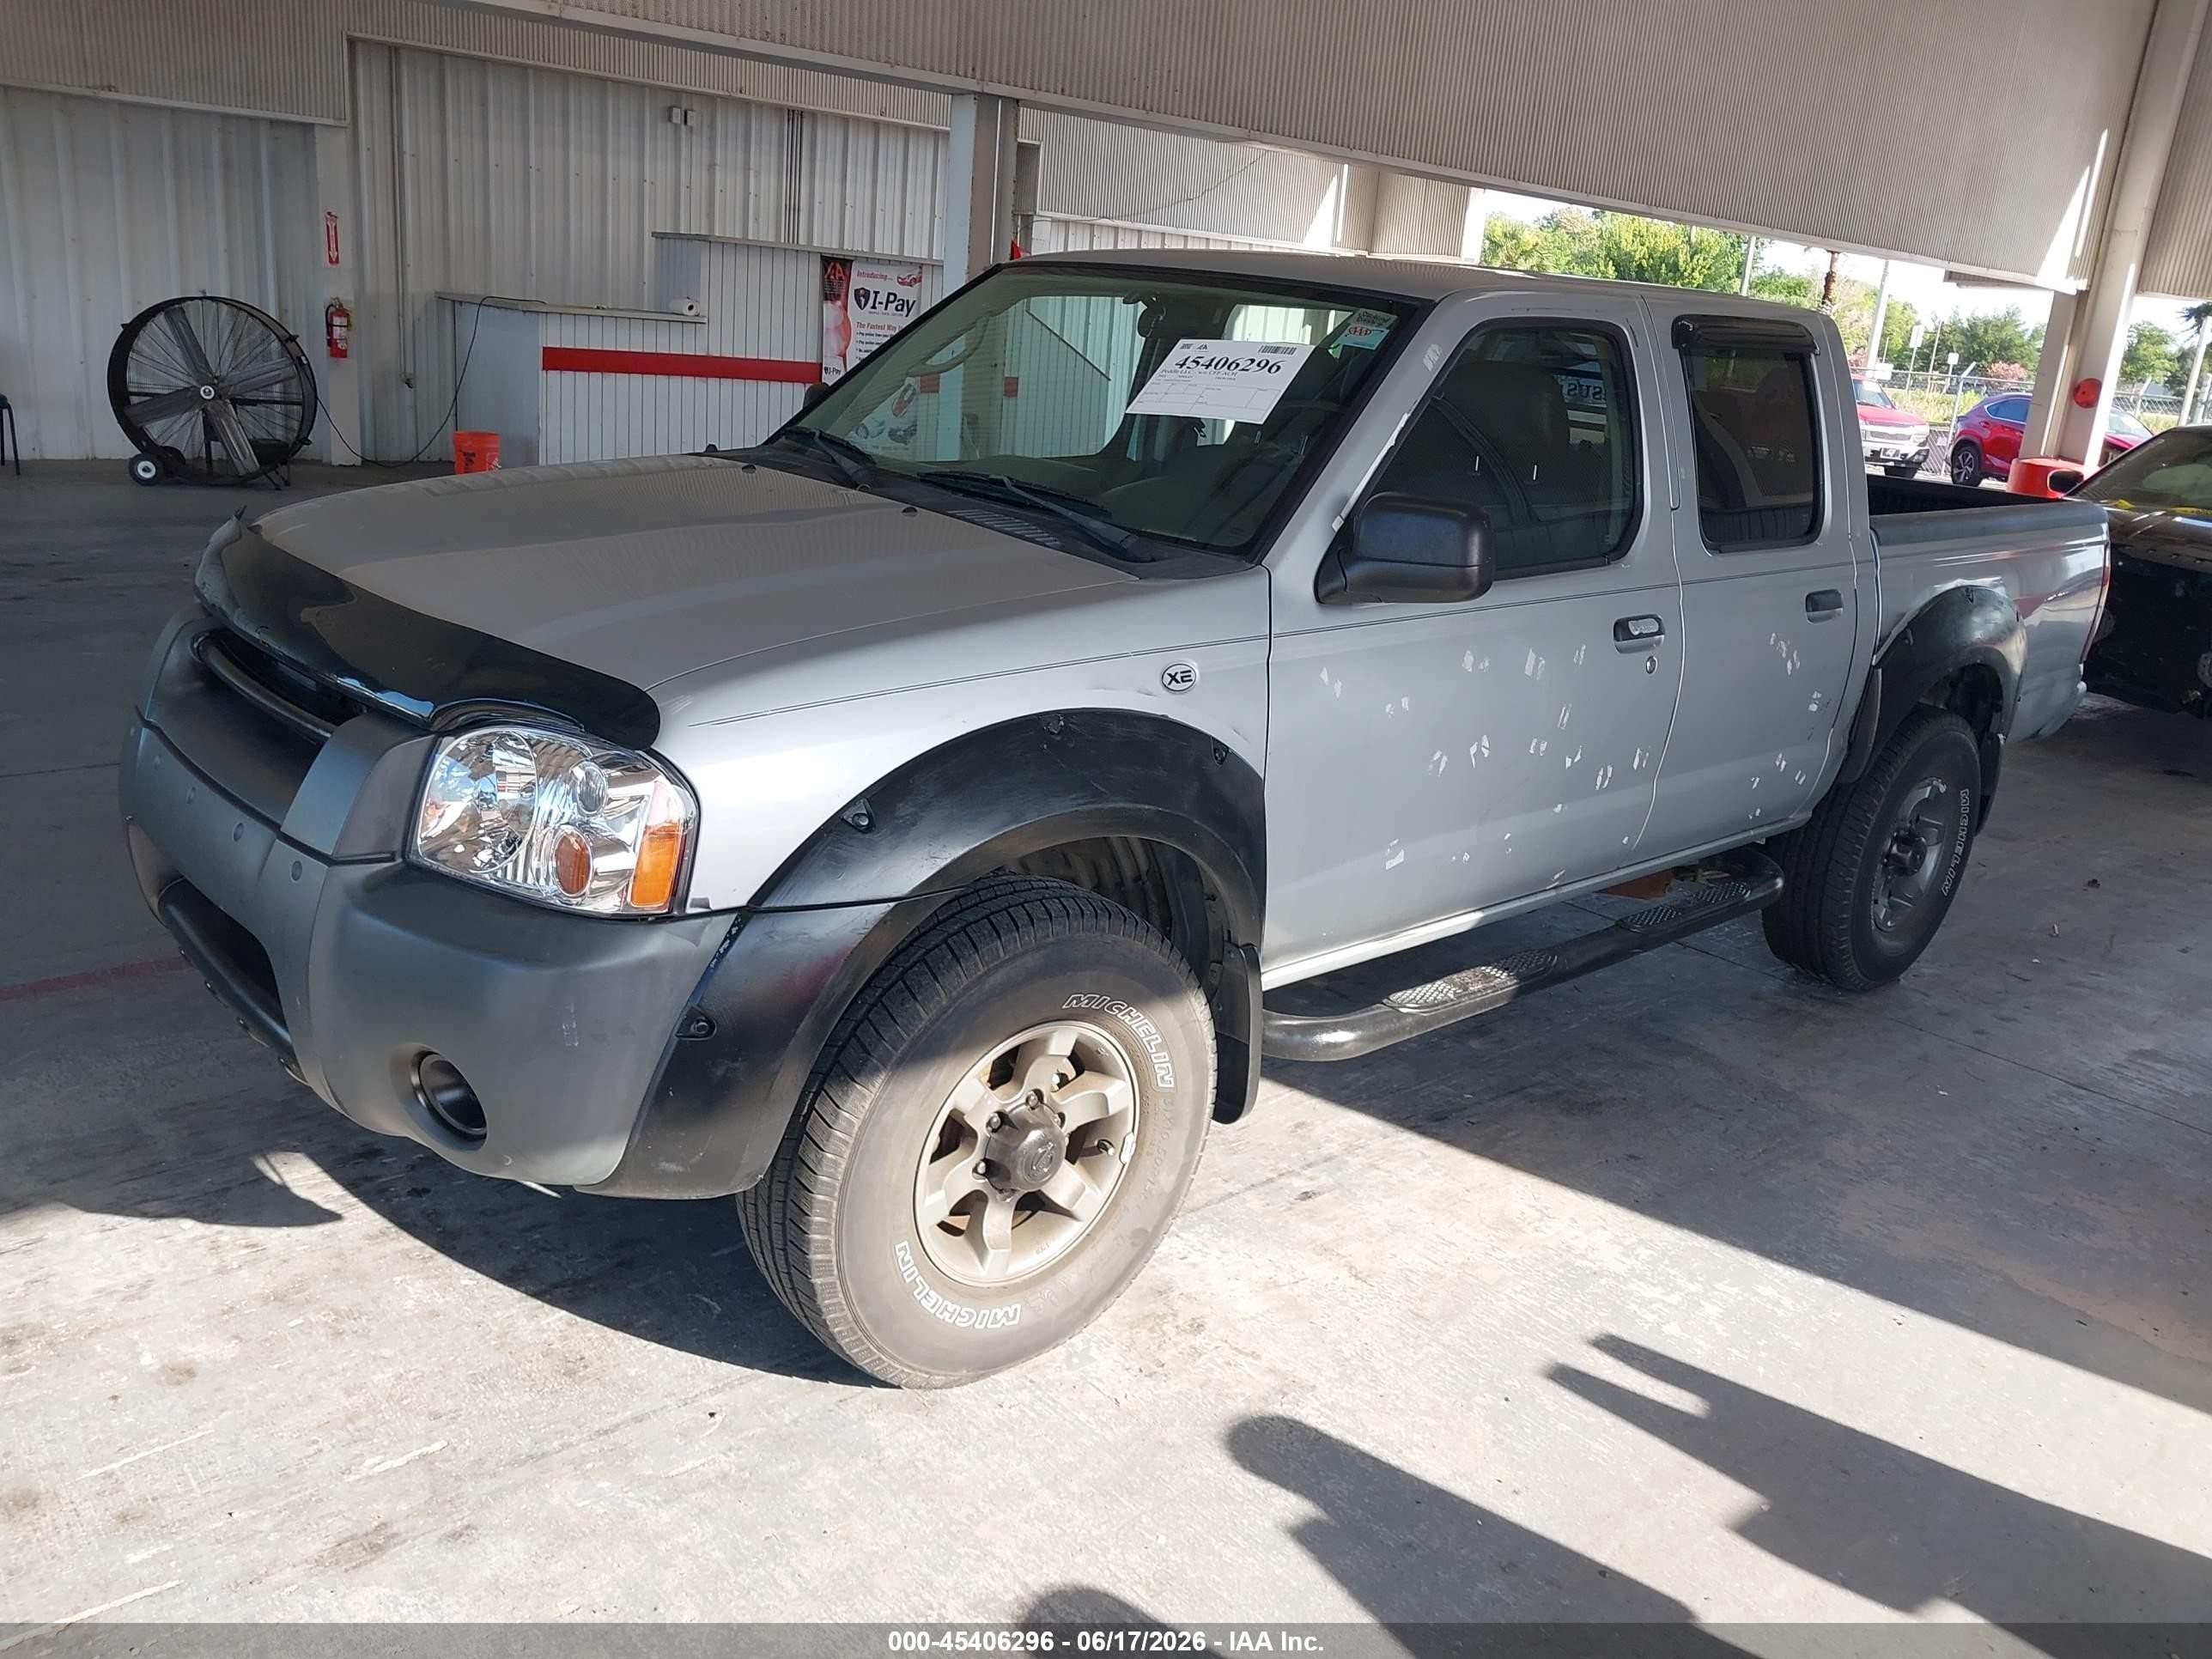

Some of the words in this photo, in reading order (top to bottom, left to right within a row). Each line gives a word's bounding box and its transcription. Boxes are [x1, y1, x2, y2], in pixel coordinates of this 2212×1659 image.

[870, 290, 917, 318] I-Pay
[1175, 356, 1285, 374] 45406296
[1166, 669, 1194, 686] XE
[1942, 787, 1970, 896] MICHELIN
[1062, 994, 1175, 1088] MICHELIN
[895, 1240, 1022, 1329] MICHELIN
